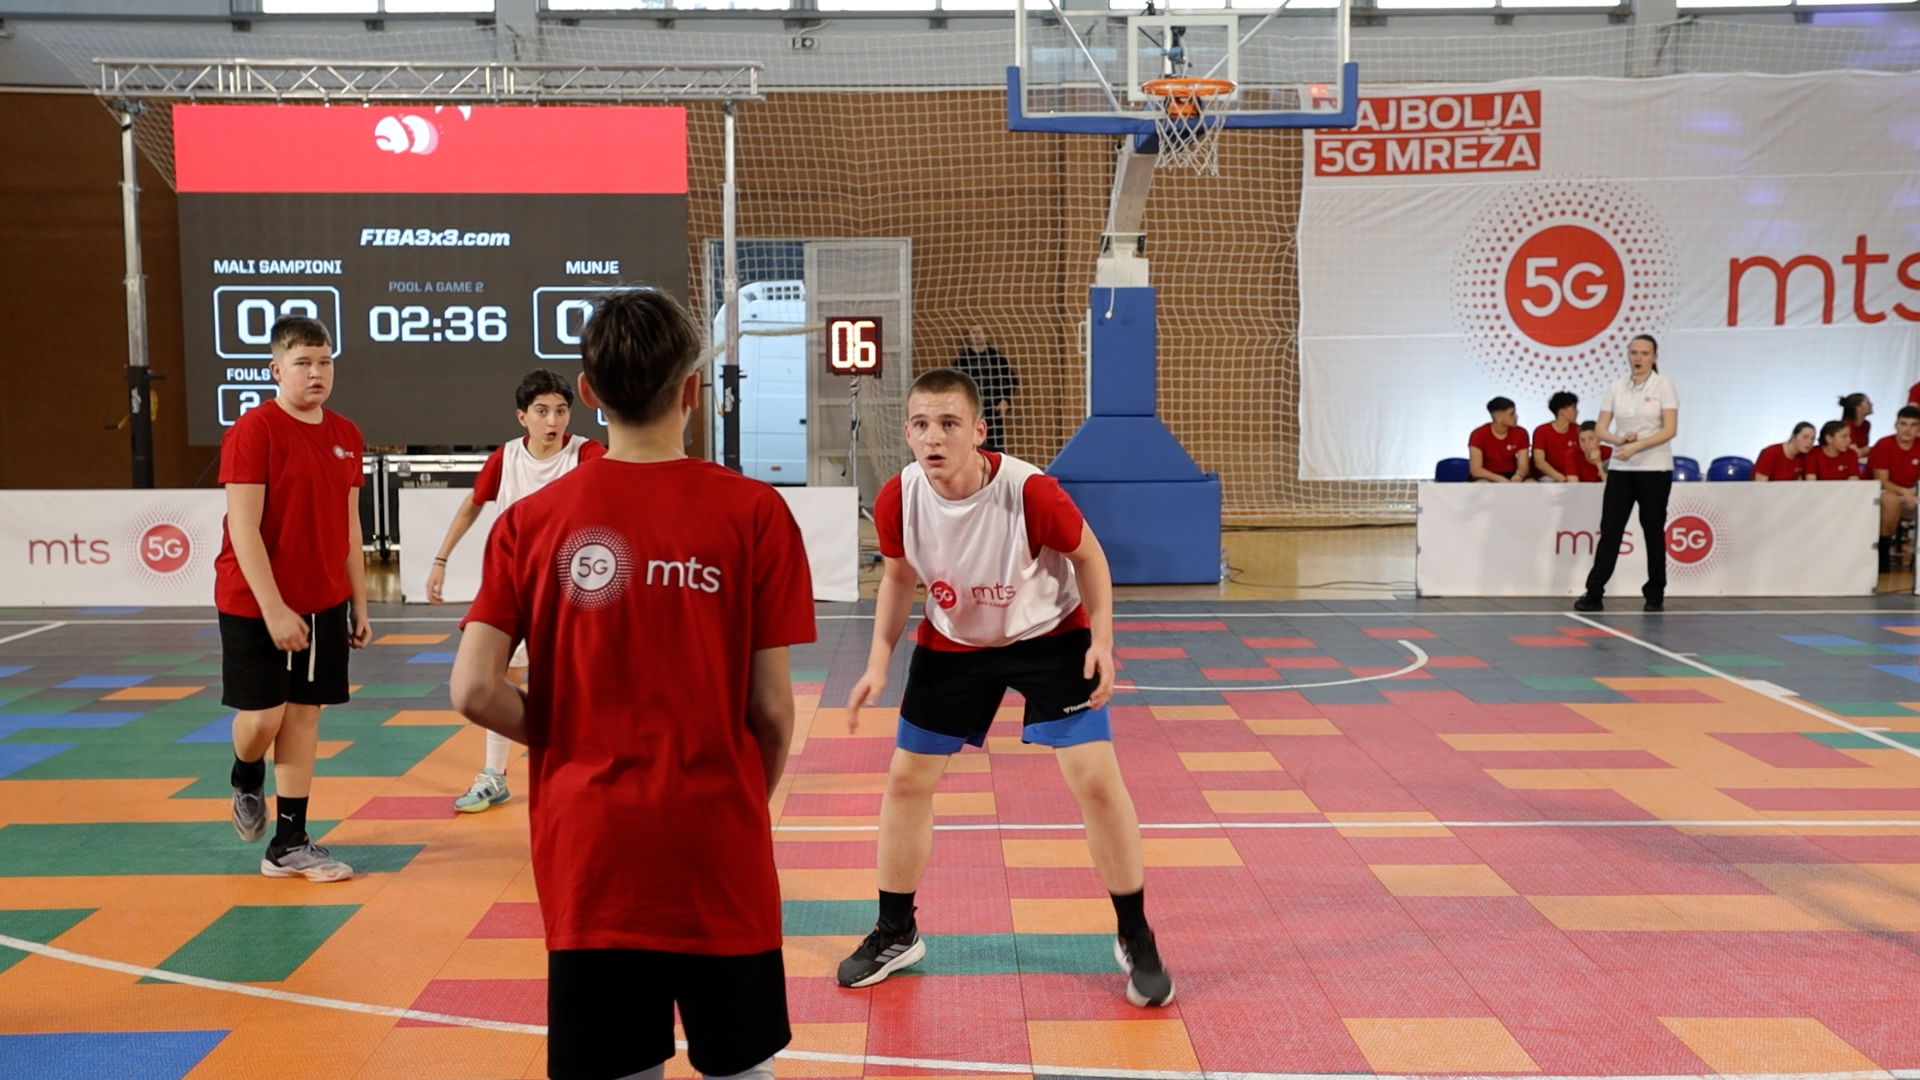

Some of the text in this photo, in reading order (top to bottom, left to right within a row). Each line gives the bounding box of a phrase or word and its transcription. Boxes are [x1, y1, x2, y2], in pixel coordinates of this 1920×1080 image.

[1320, 127, 1536, 173] 5G MREŽA
[360, 229, 511, 246] FIBA3x3.com
[214, 260, 342, 274] MALI SAMPIONI
[566, 261, 619, 274] MUNJE
[388, 281, 484, 292] POOL A GAME 2
[1521, 257, 1609, 317] 5G
[369, 306, 508, 342] 02:36
[831, 320, 878, 370] 06
[226, 368, 271, 381] FOULS
[29, 533, 183, 565] mts 5G
[1556, 527, 1707, 555] ms 5G
[577, 556, 721, 593] 5G mts
[933, 582, 1017, 603] 5G mts
